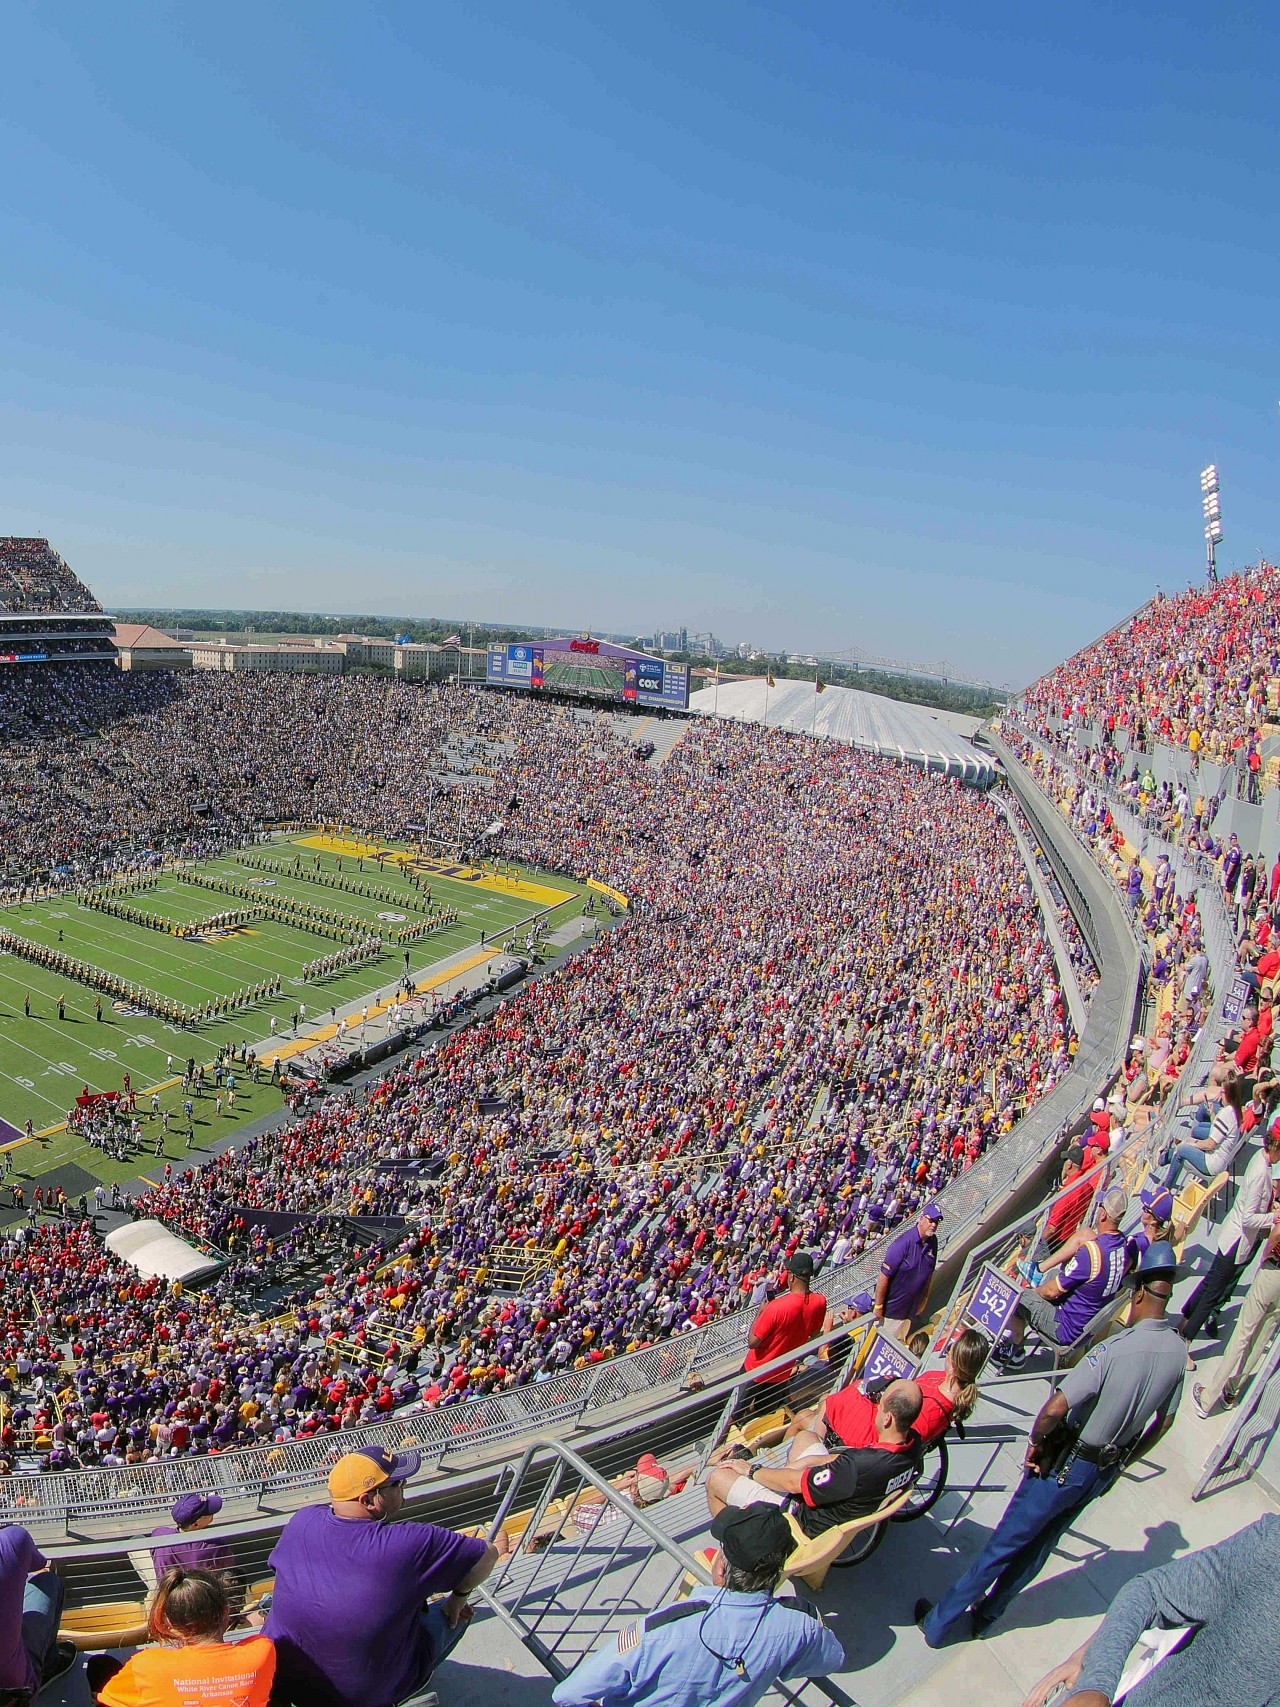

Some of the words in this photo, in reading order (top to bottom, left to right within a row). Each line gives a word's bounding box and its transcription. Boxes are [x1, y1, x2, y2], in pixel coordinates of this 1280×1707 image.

[488, 644, 507, 654] LSU
[665, 664, 685, 674] LSU
[638, 678, 660, 690] COX
[1232, 986, 1245, 998] 541
[1225, 1002, 1239, 1015] 542
[126, 1034, 156, 1048] 20
[89, 1047, 118, 1061] 15
[47, 1061, 78, 1076] 10
[14, 1075, 35, 1088] 5
[986, 1278, 1011, 1301] SECTION
[978, 1286, 1007, 1318] 542
[880, 1346, 907, 1373] SECTION
[813, 1468, 831, 1486] 8
[173, 1677, 210, 1686] National
[211, 1670, 257, 1684] Invitational
[201, 1690, 233, 1699] Arkansas
